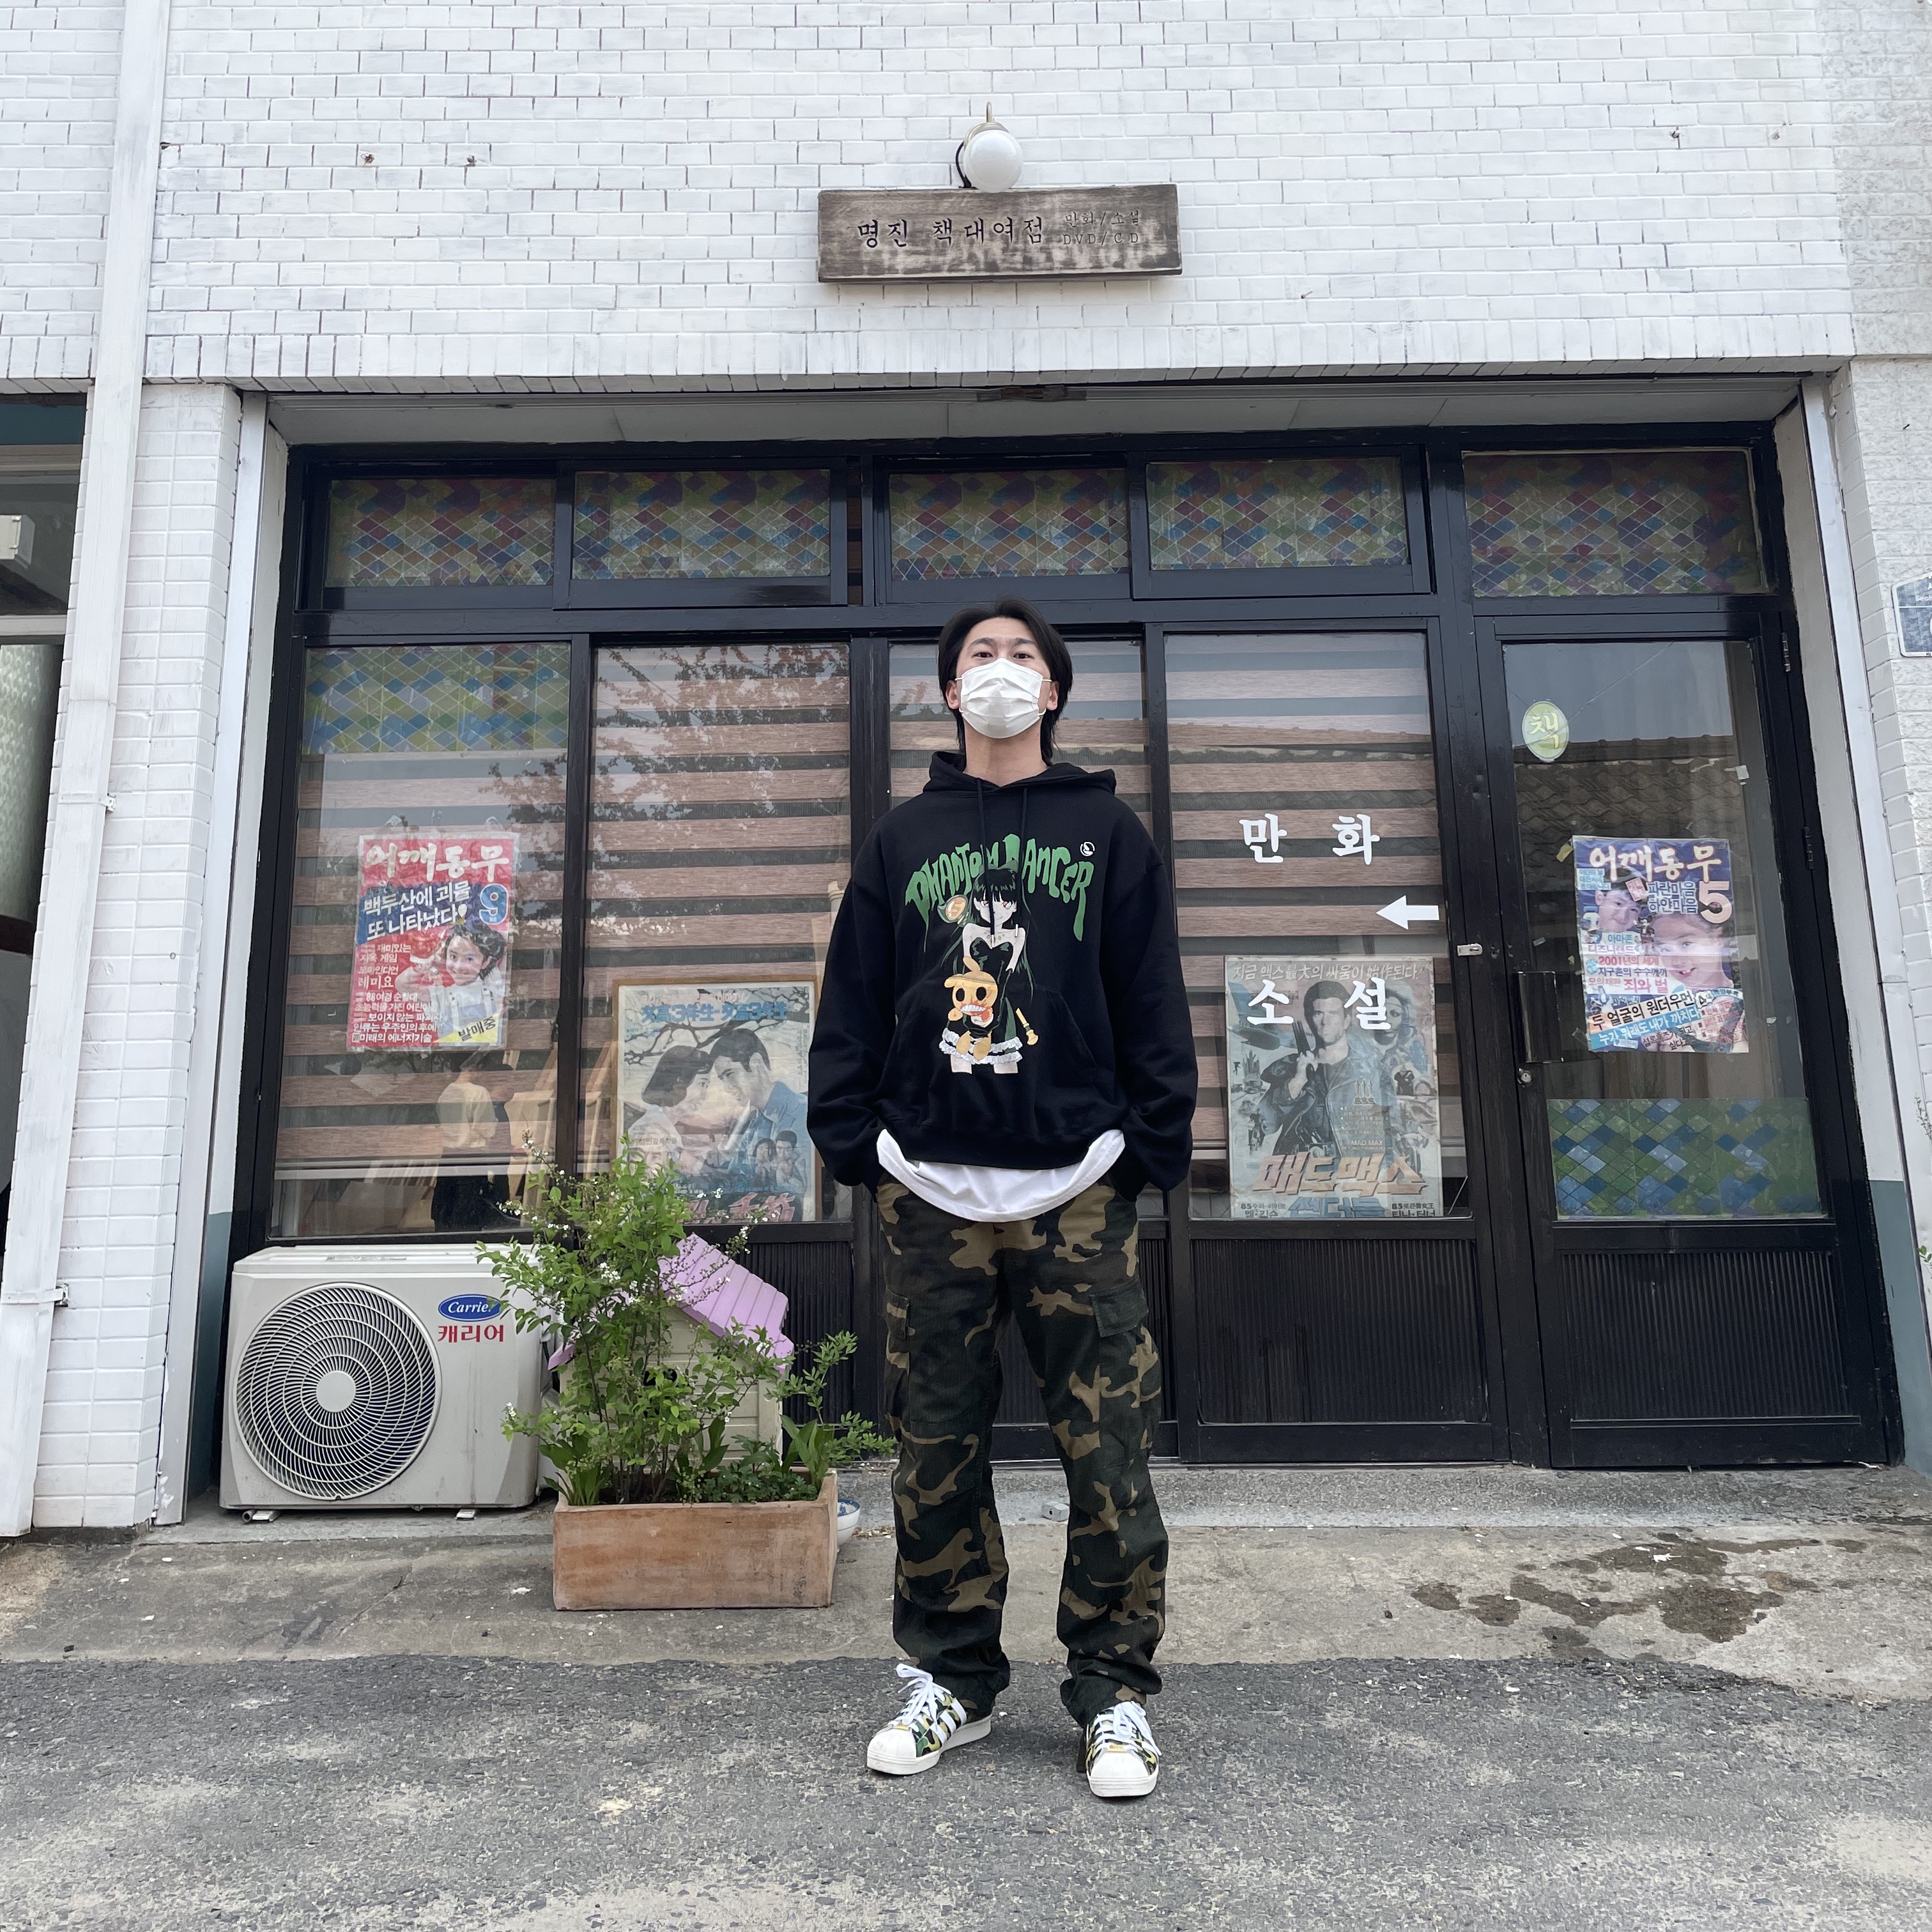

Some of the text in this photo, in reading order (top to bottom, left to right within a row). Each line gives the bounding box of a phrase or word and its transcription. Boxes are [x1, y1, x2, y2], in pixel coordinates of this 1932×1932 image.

[857, 219, 908, 249] 명진
[1529, 712, 1560, 749] 책
[365, 843, 510, 882] 어깨동무
[1589, 845, 1722, 884] 어깨동무
[364, 880, 471, 916] 백두산에 괴물
[479, 883, 509, 925] 9
[1699, 880, 1733, 924] 5
[367, 920, 386, 942] 또
[1607, 933, 1634, 944] 아마존
[1588, 944, 1636, 954] 디즈니랜드
[1232, 963, 1258, 981] 지금
[1326, 963, 1364, 981] 싸움이
[1654, 978, 1669, 993] 벌
[367, 1013, 395, 1023] 보이지
[1592, 1014, 1606, 1031] 두
[1607, 1003, 1646, 1027] 얼굴의
[1646, 990, 1695, 1016] 원더우먼
[457, 1016, 496, 1042] 발매중
[1252, 1151, 1429, 1197] 매드맥스
[448, 1301, 491, 1314] Carrie
[438, 1324, 504, 1343] 캐리어
